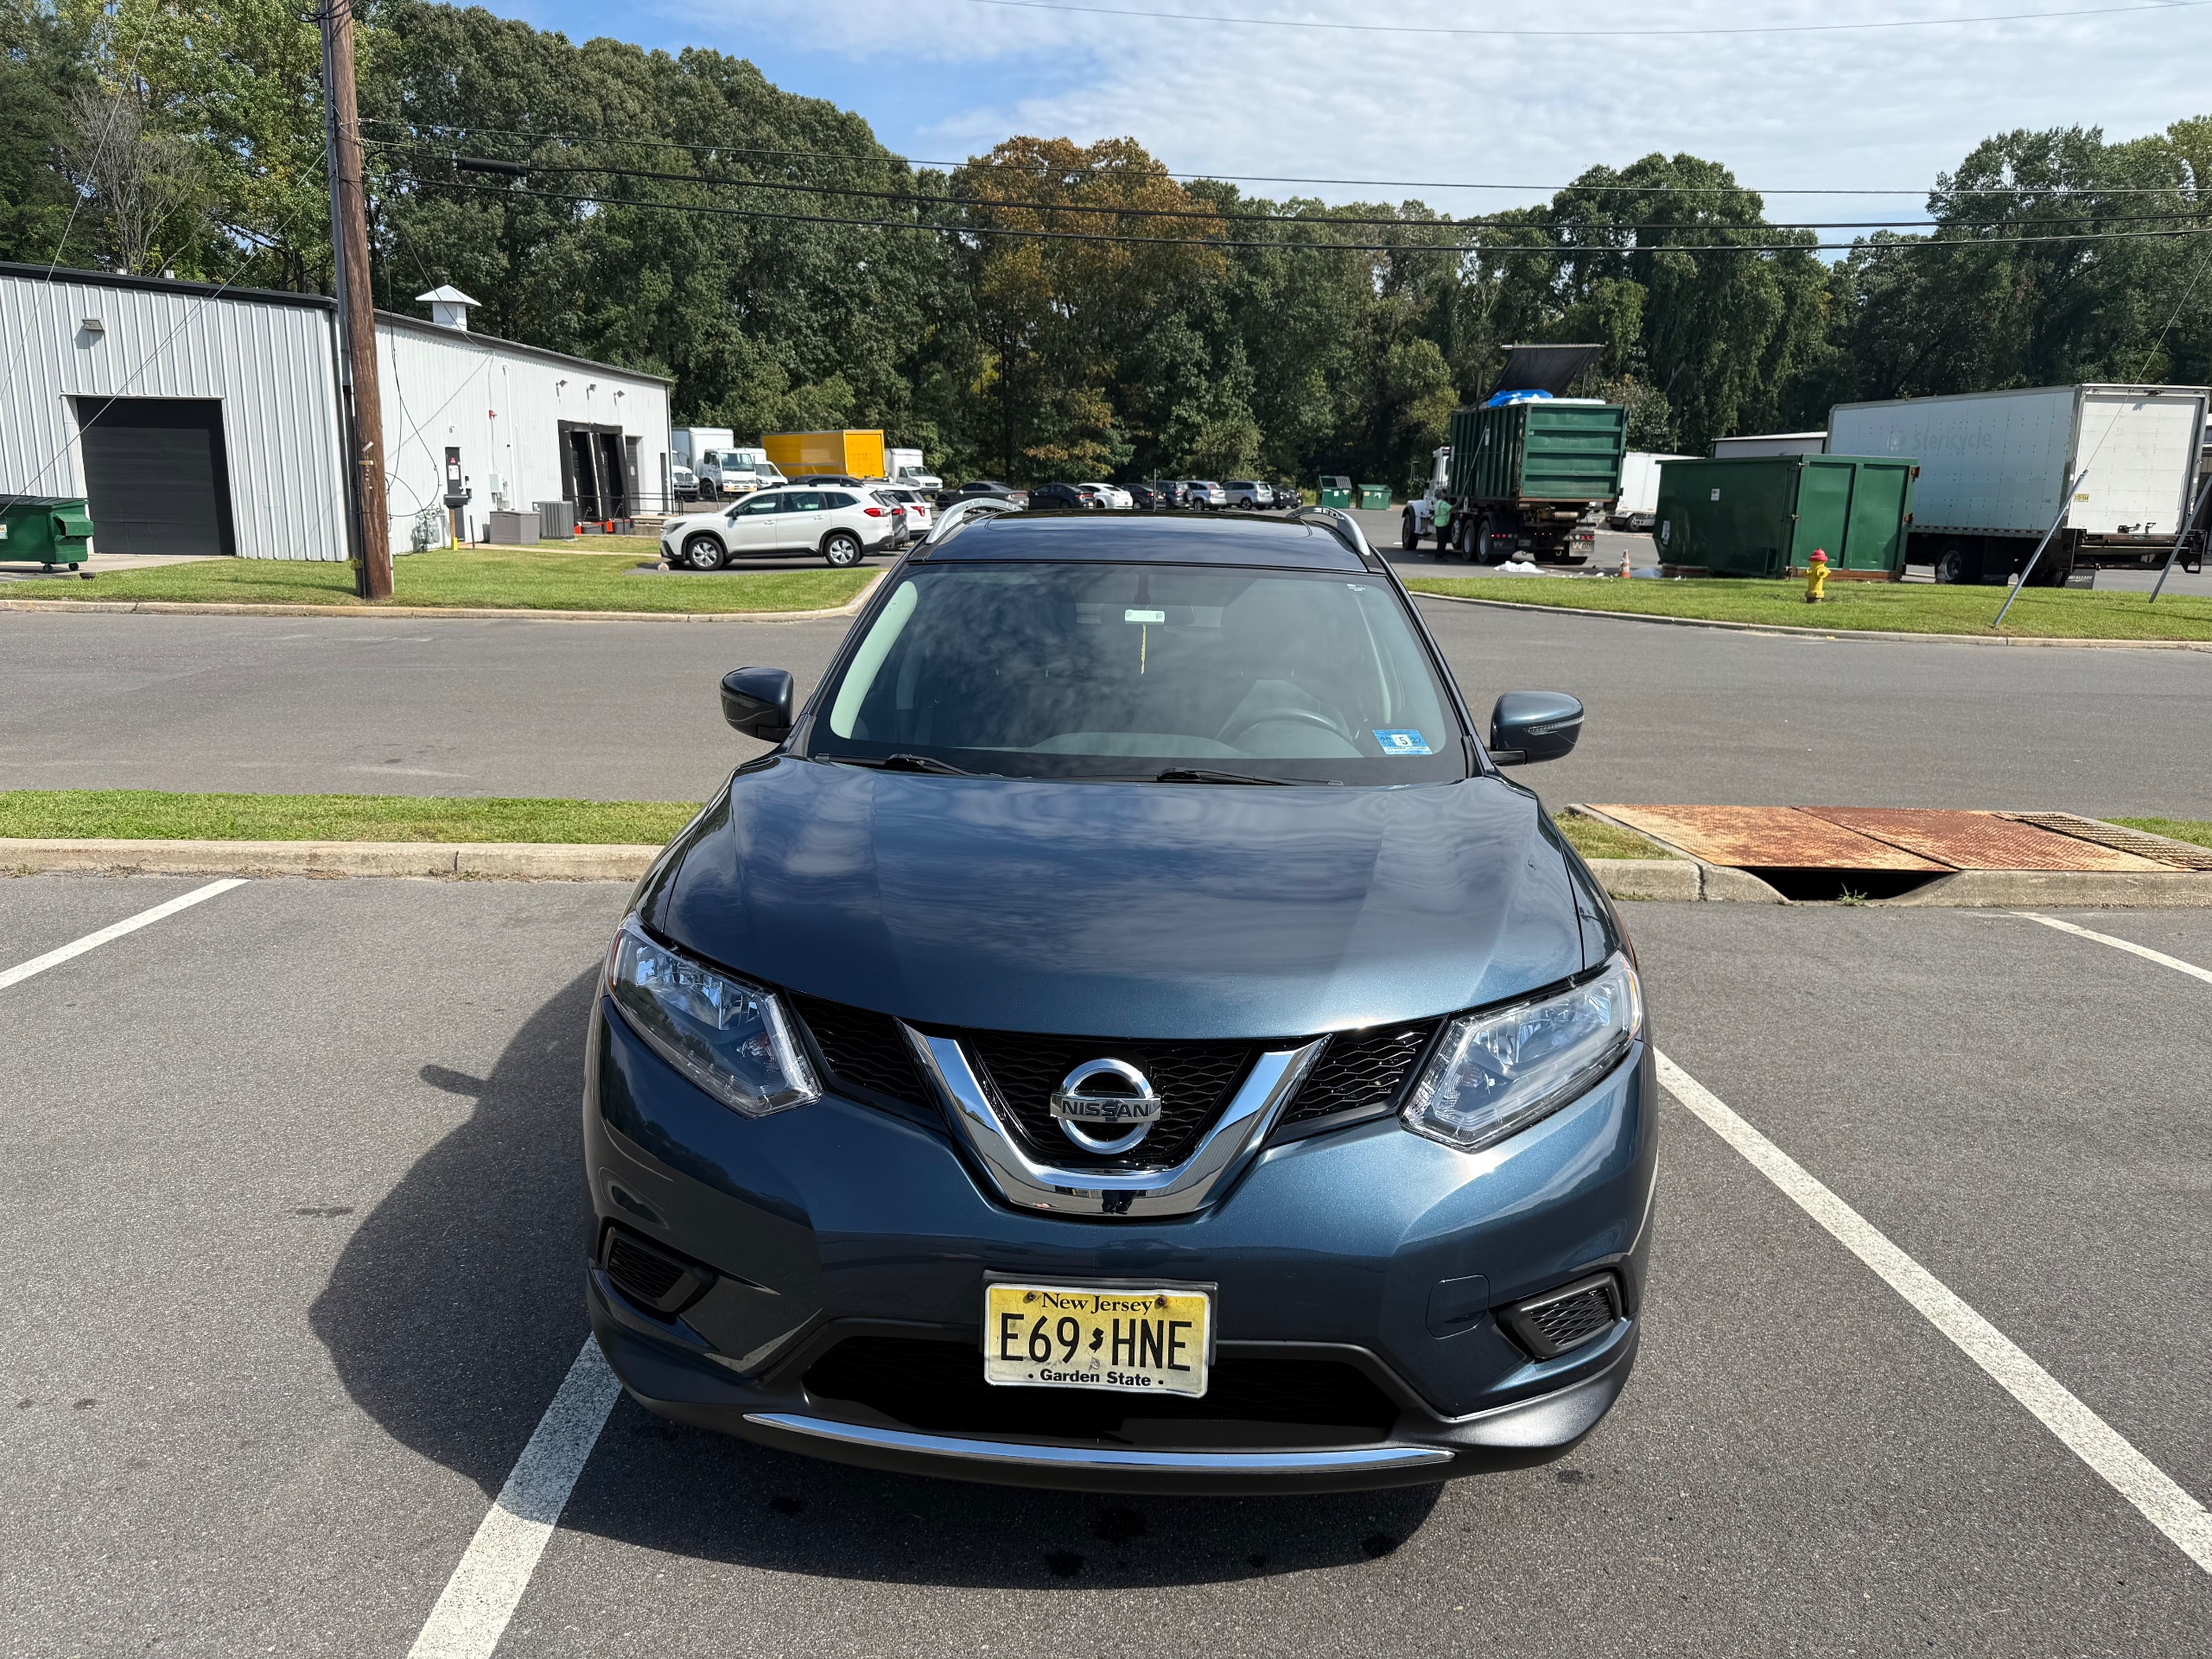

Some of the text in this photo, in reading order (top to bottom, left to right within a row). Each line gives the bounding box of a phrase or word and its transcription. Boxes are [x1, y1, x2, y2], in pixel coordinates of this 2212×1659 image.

[1913, 429, 1993, 451] Stericycle
[1398, 736, 1408, 745] 5
[1062, 1100, 1149, 1118] NISSAN
[1041, 1292, 1154, 1315] New Jersey
[1001, 1312, 1192, 1372] E69 HNE
[1039, 1368, 1152, 1387] Garden State
